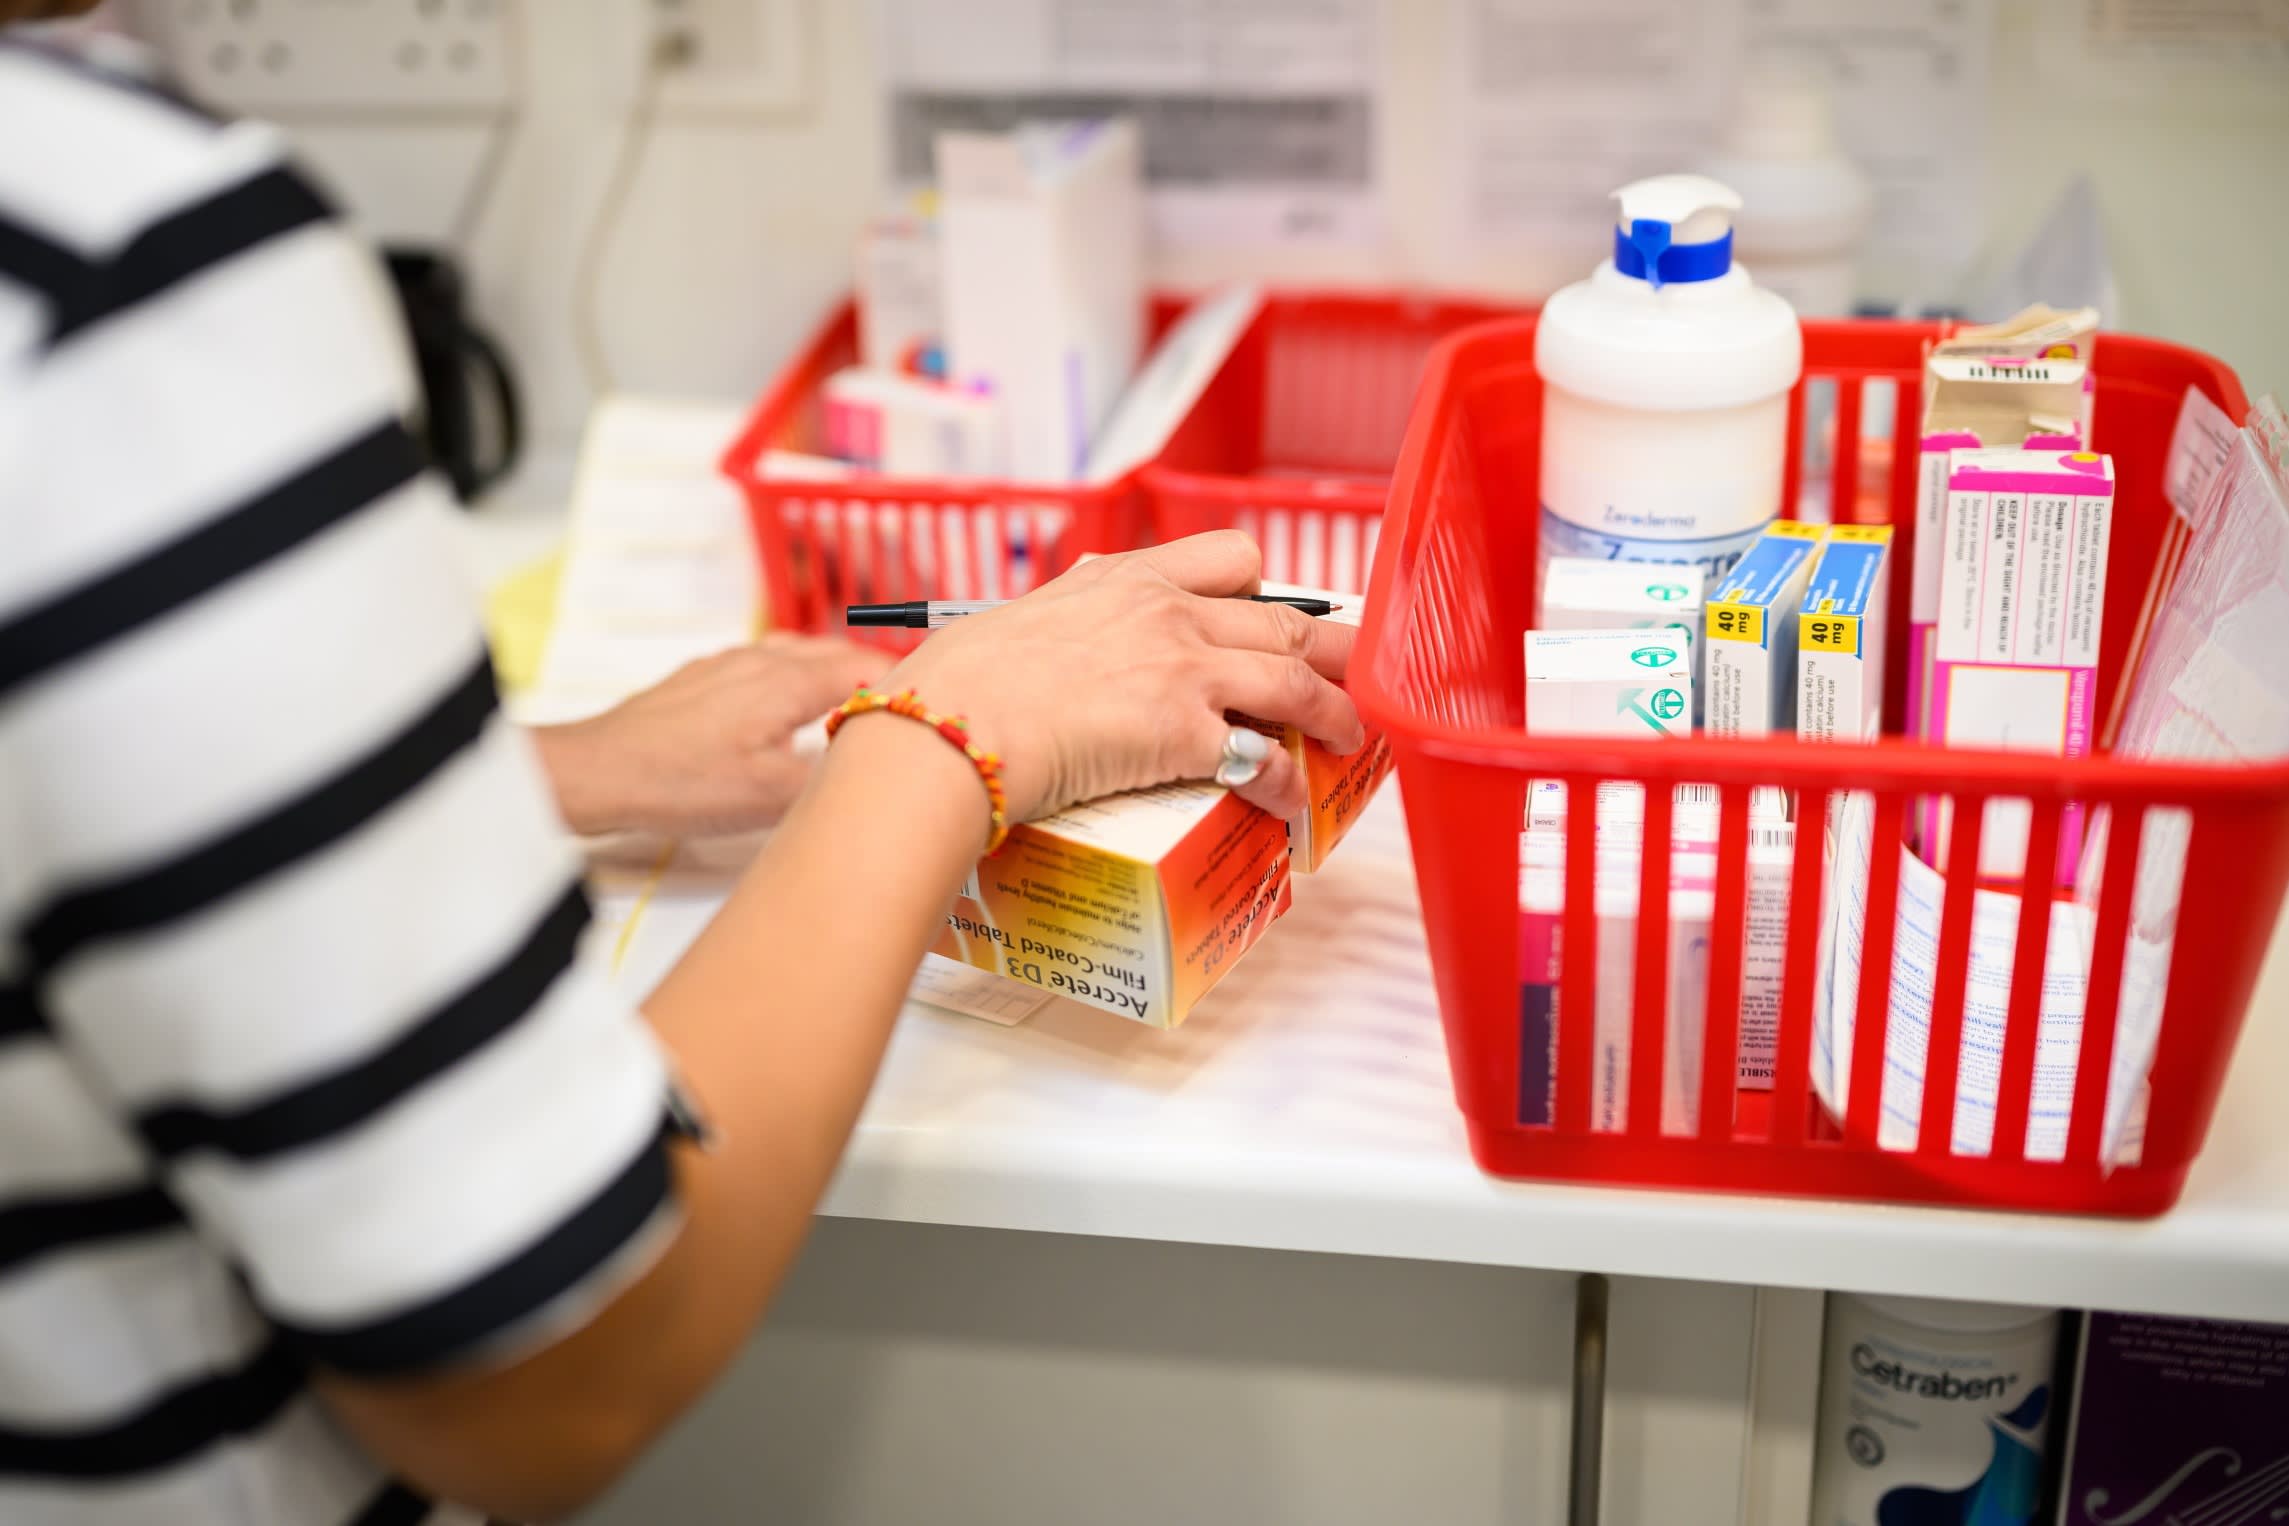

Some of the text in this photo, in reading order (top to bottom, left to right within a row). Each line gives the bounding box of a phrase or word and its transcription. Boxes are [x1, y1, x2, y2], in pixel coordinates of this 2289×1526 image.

[1718, 612, 1734, 631] 40
[1737, 612, 1750, 633] mg
[1812, 623, 1828, 643] 40
[1831, 623, 1844, 644] mg
[1714, 649, 1721, 663] mg
[1806, 661, 1815, 675] mg
[1712, 666, 1720, 677] 40
[1722, 664, 1730, 701] calcium)
[1805, 678, 1812, 688] 40
[1815, 675, 1824, 712] calcium)
[1827, 680, 1835, 694] use
[1732, 688, 1741, 715] before
[1805, 692, 1813, 728] contains
[1825, 698, 1834, 726] before
[1321, 776, 1348, 812] Tablets
[1223, 859, 1279, 930] Film-Coated
[1229, 879, 1280, 945] Accrete
[1006, 957, 1042, 985] D3
[1021, 938, 1146, 991] Film-Coated
[1051, 971, 1148, 1018] Accrete
[1850, 1342, 2006, 1401] Cetraben
